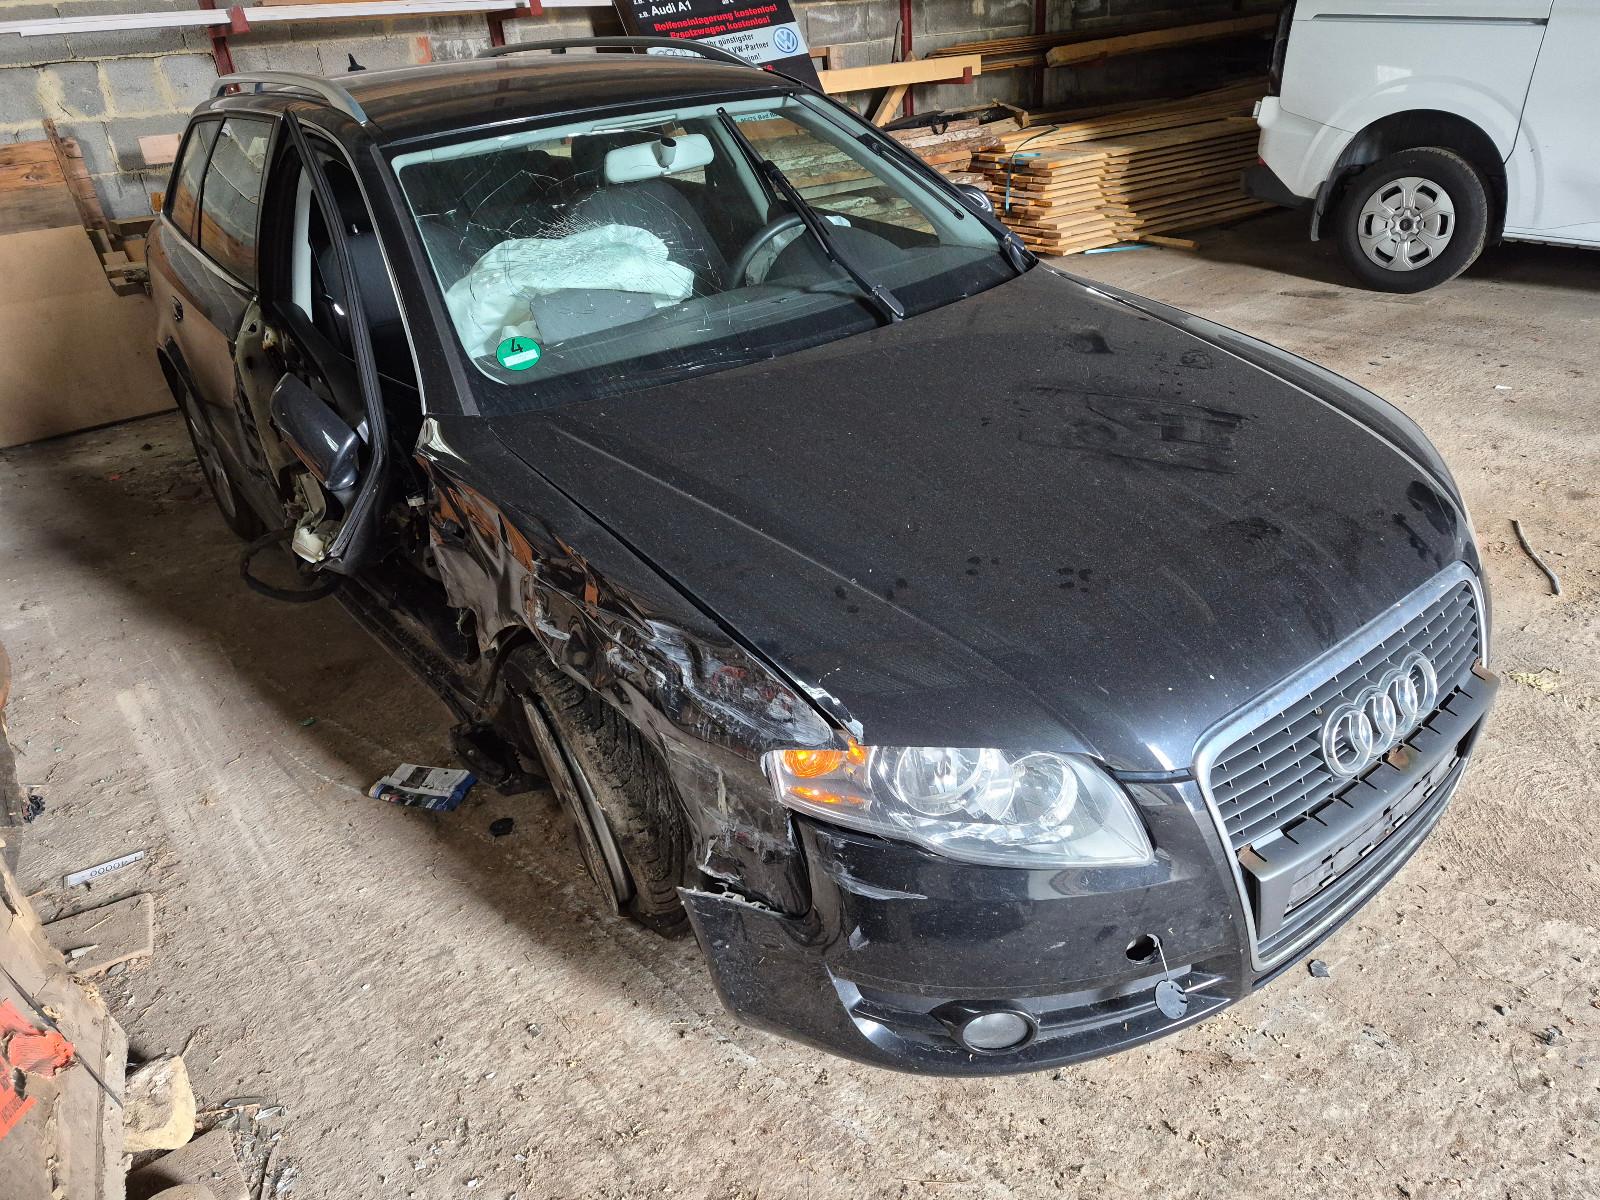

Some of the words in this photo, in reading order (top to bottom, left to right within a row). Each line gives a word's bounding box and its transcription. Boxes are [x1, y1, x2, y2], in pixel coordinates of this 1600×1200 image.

[651, 3, 677, 16] Audi
[678, 0, 692, 11] A1
[734, 4, 778, 18] kostenlos!
[727, 16, 771, 29] kostenlos!
[719, 33, 754, 46] günstigster
[732, 41, 769, 54] VW-Partner
[511, 338, 523, 352] 4
